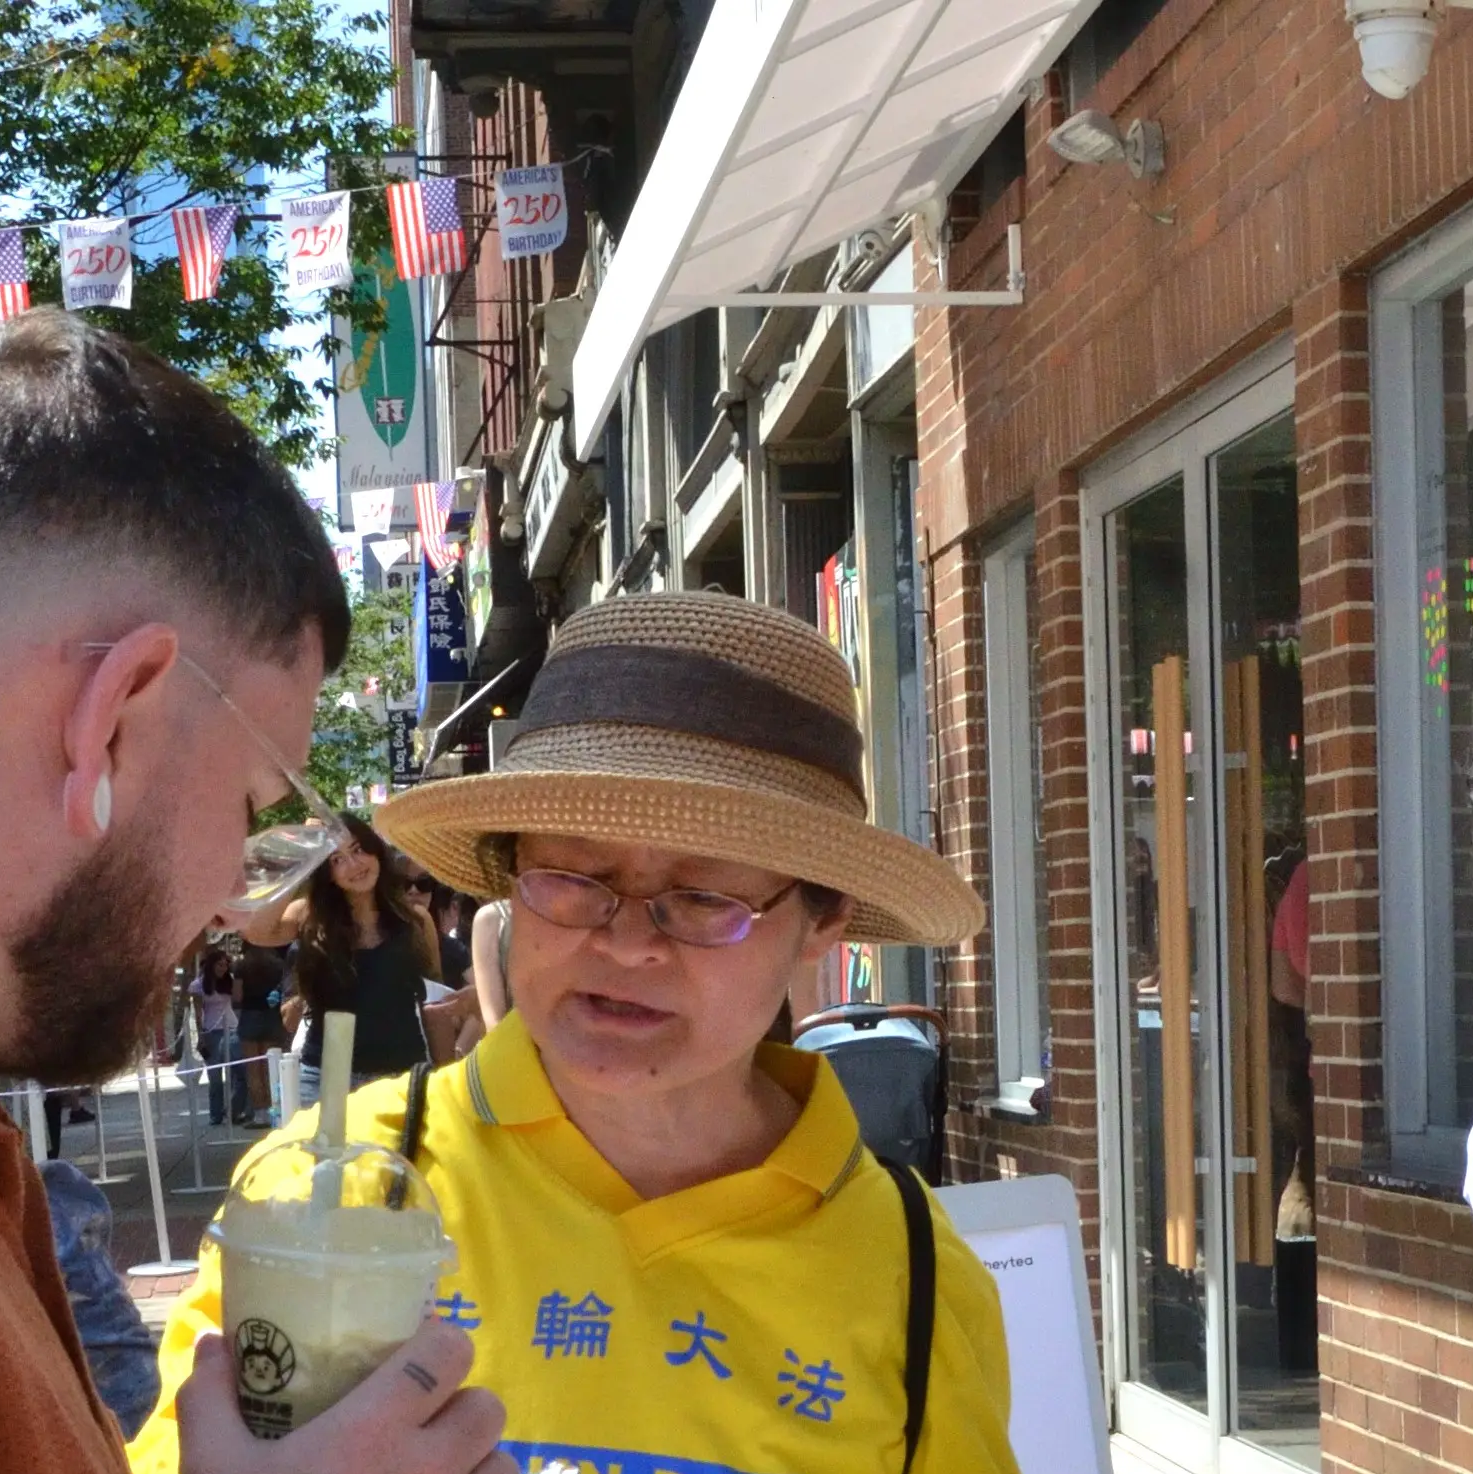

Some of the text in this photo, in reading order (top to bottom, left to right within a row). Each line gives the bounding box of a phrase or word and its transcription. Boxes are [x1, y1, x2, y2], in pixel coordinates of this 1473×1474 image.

[502, 167, 558, 187] AMERICA'S
[503, 193, 562, 226] 250
[291, 224, 343, 258] 250
[67, 245, 126, 276] 250
[296, 262, 346, 285] BIRTHDAY!
[70, 284, 126, 303] BIRTHDAY!
[343, 465, 423, 488] Malaysian
[982, 1256, 1034, 1272] heytea
